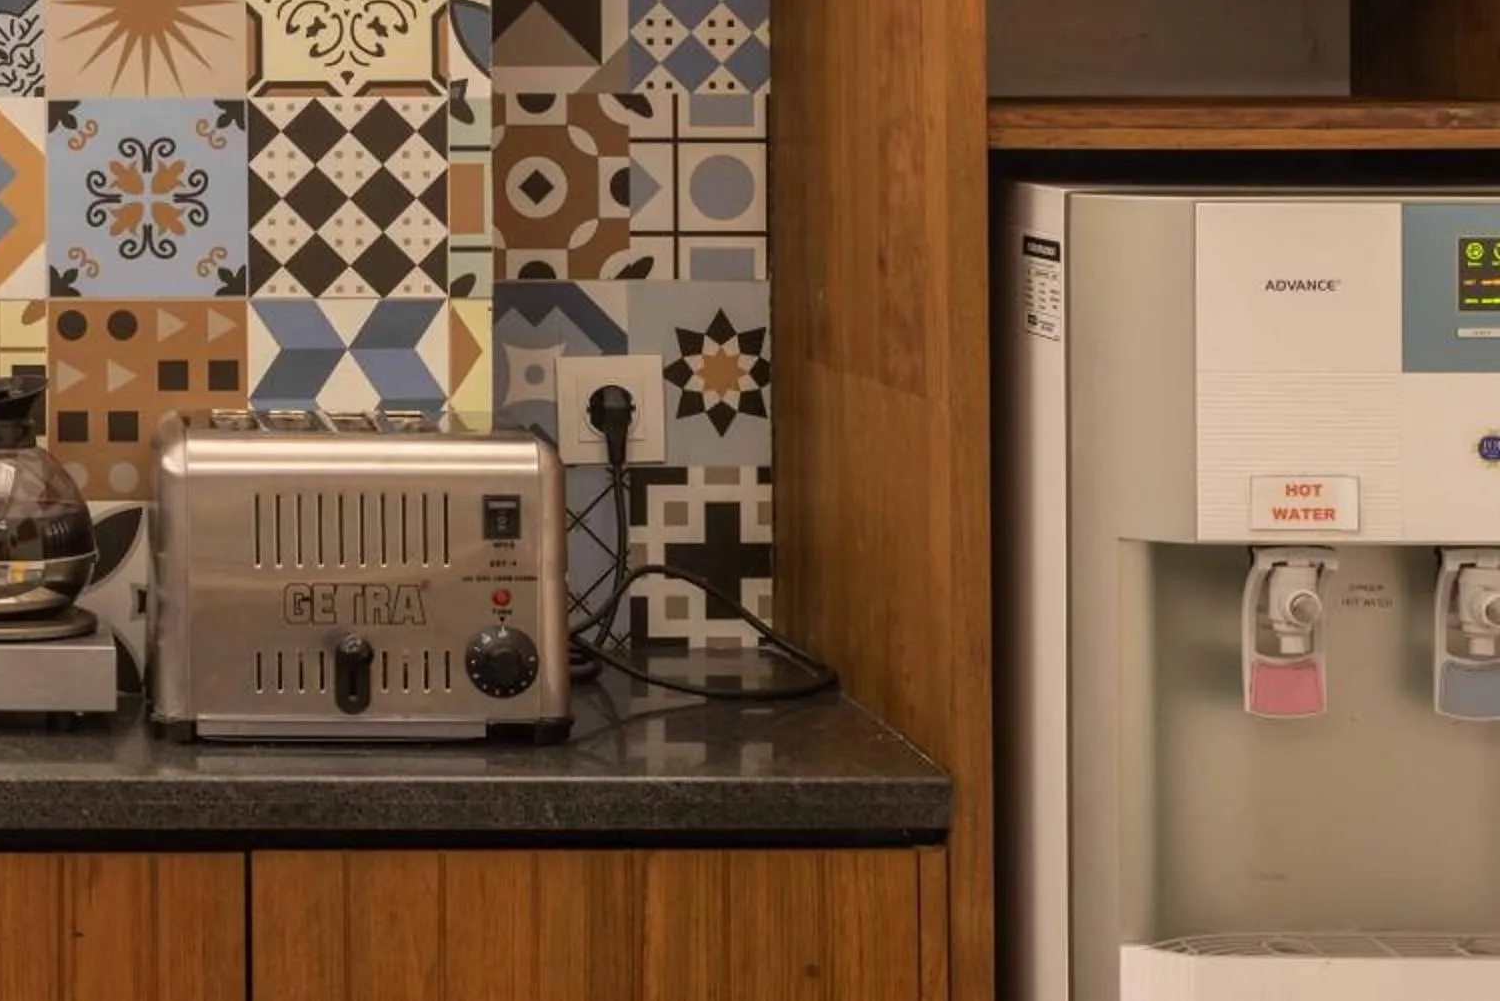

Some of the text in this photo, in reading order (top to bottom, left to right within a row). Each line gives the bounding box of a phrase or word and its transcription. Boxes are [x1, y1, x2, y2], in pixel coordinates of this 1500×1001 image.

[1264, 278, 1336, 292] ADVANCE
[1285, 483, 1323, 497] HOT
[1272, 507, 1337, 521] WATER
[284, 582, 426, 625] GETRA
